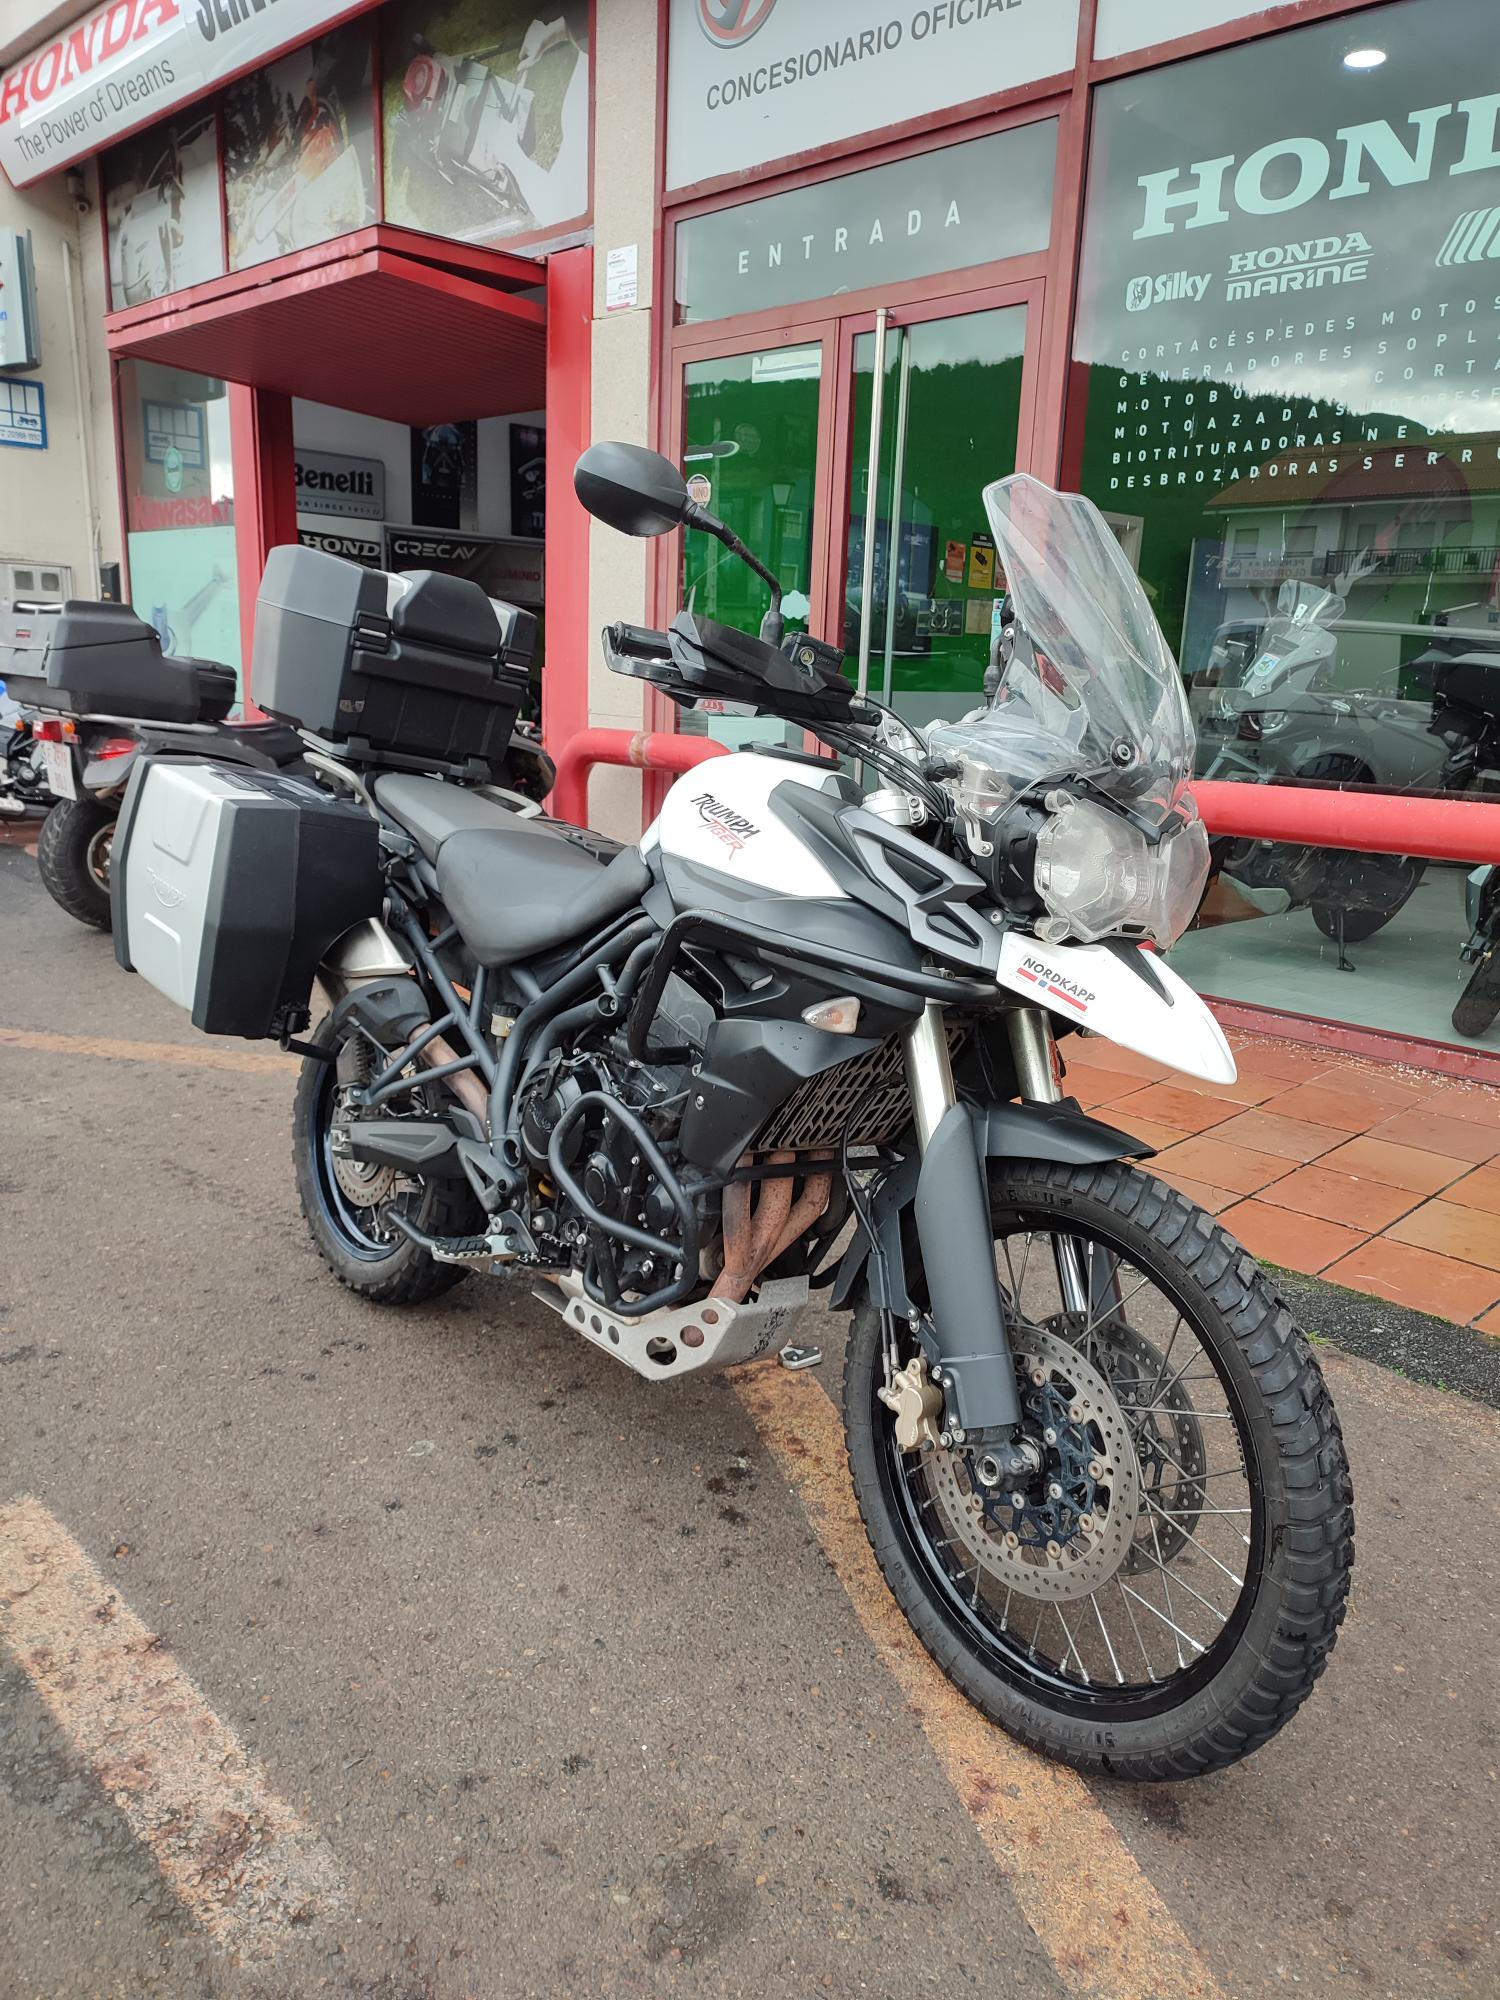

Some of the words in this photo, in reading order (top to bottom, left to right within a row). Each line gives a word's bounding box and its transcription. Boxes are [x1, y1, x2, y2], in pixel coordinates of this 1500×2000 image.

[706, 20, 902, 110] CONCESIONARIO
[14, 129, 46, 162] The
[40, 106, 90, 149] Power
[89, 88, 108, 123] of
[105, 59, 175, 112] Dreams
[738, 200, 961, 274] ENTRADA
[1227, 231, 1372, 275] HONDA
[1153, 270, 1212, 304] Silky
[1121, 316, 1355, 362] CORTACÉSPEDES
[1119, 345, 1352, 388] GENERADORES
[1114, 402, 1345, 439] MOTOAZADAS
[1112, 431, 1342, 464] BIOTRITURADORAS
[296, 462, 373, 496] Benelli
[1110, 461, 1338, 489] DESBROZADORAS
[394, 540, 477, 560] GRECAV
[690, 792, 762, 840] TRIUMPH
[697, 817, 748, 862] TIGER
[1022, 957, 1096, 1002] NORDKAPP
